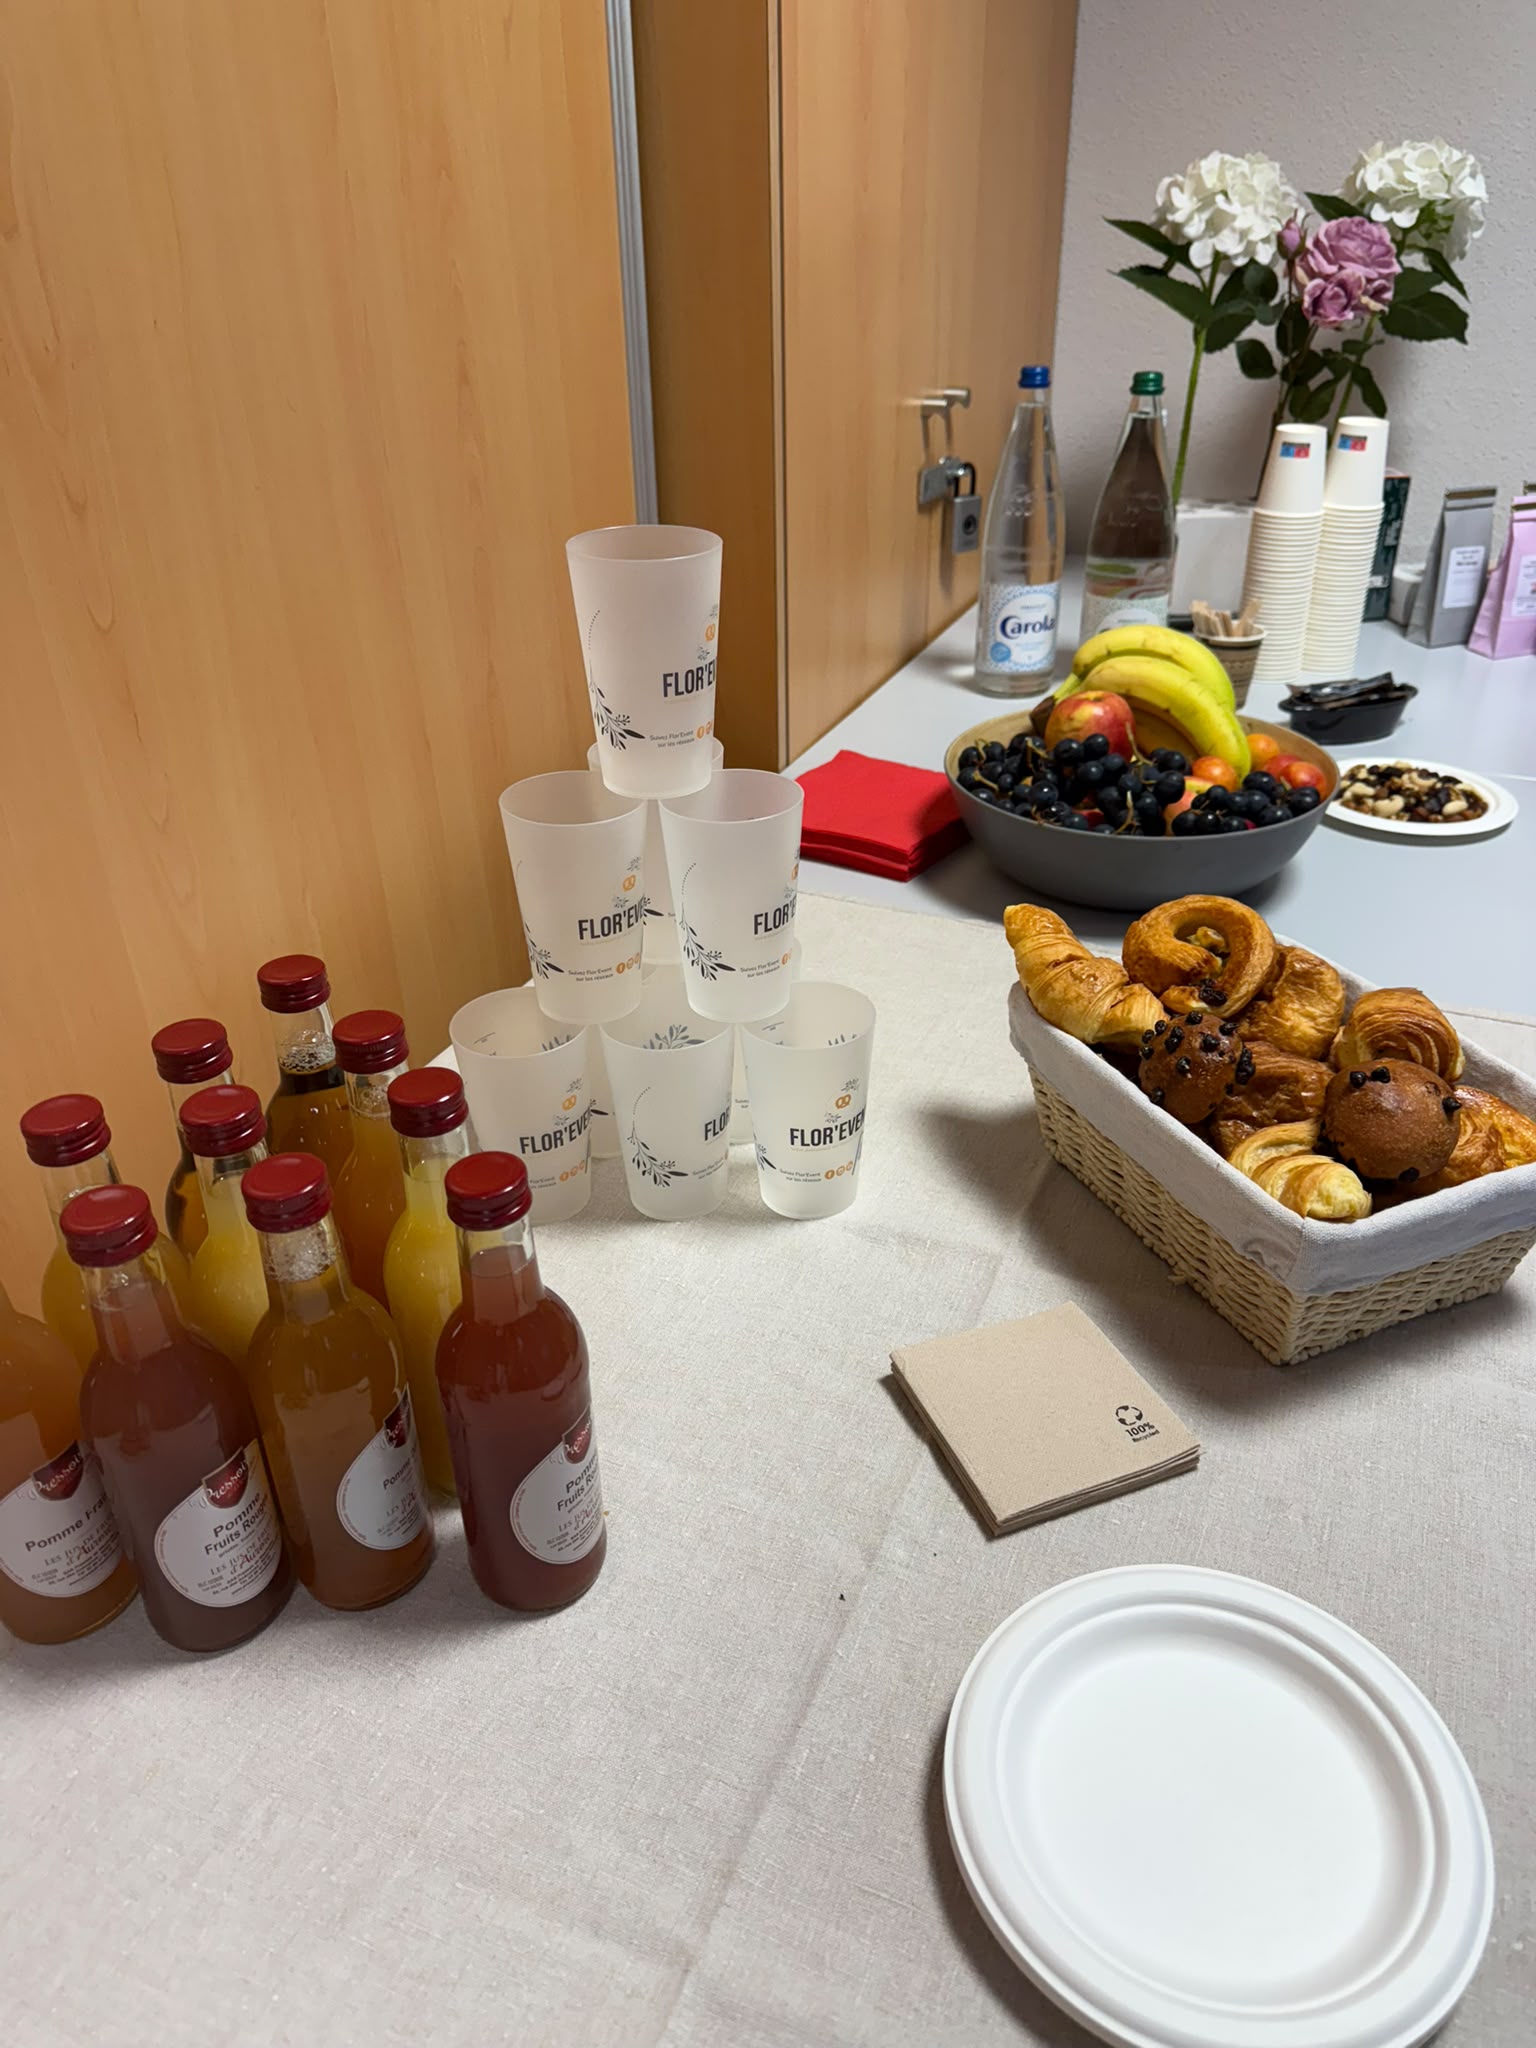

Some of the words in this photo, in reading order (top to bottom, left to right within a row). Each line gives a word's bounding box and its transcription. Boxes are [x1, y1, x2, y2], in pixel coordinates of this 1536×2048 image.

[1000, 615, 1055, 640] Carola
[1125, 1421, 1155, 1437] 100%
[566, 1452, 599, 1494] Pomm
[557, 1484, 585, 1512] Fruits
[213, 1492, 261, 1538] Pomme
[25, 1518, 84, 1552] Pomme
[204, 1530, 241, 1556] Fruits
